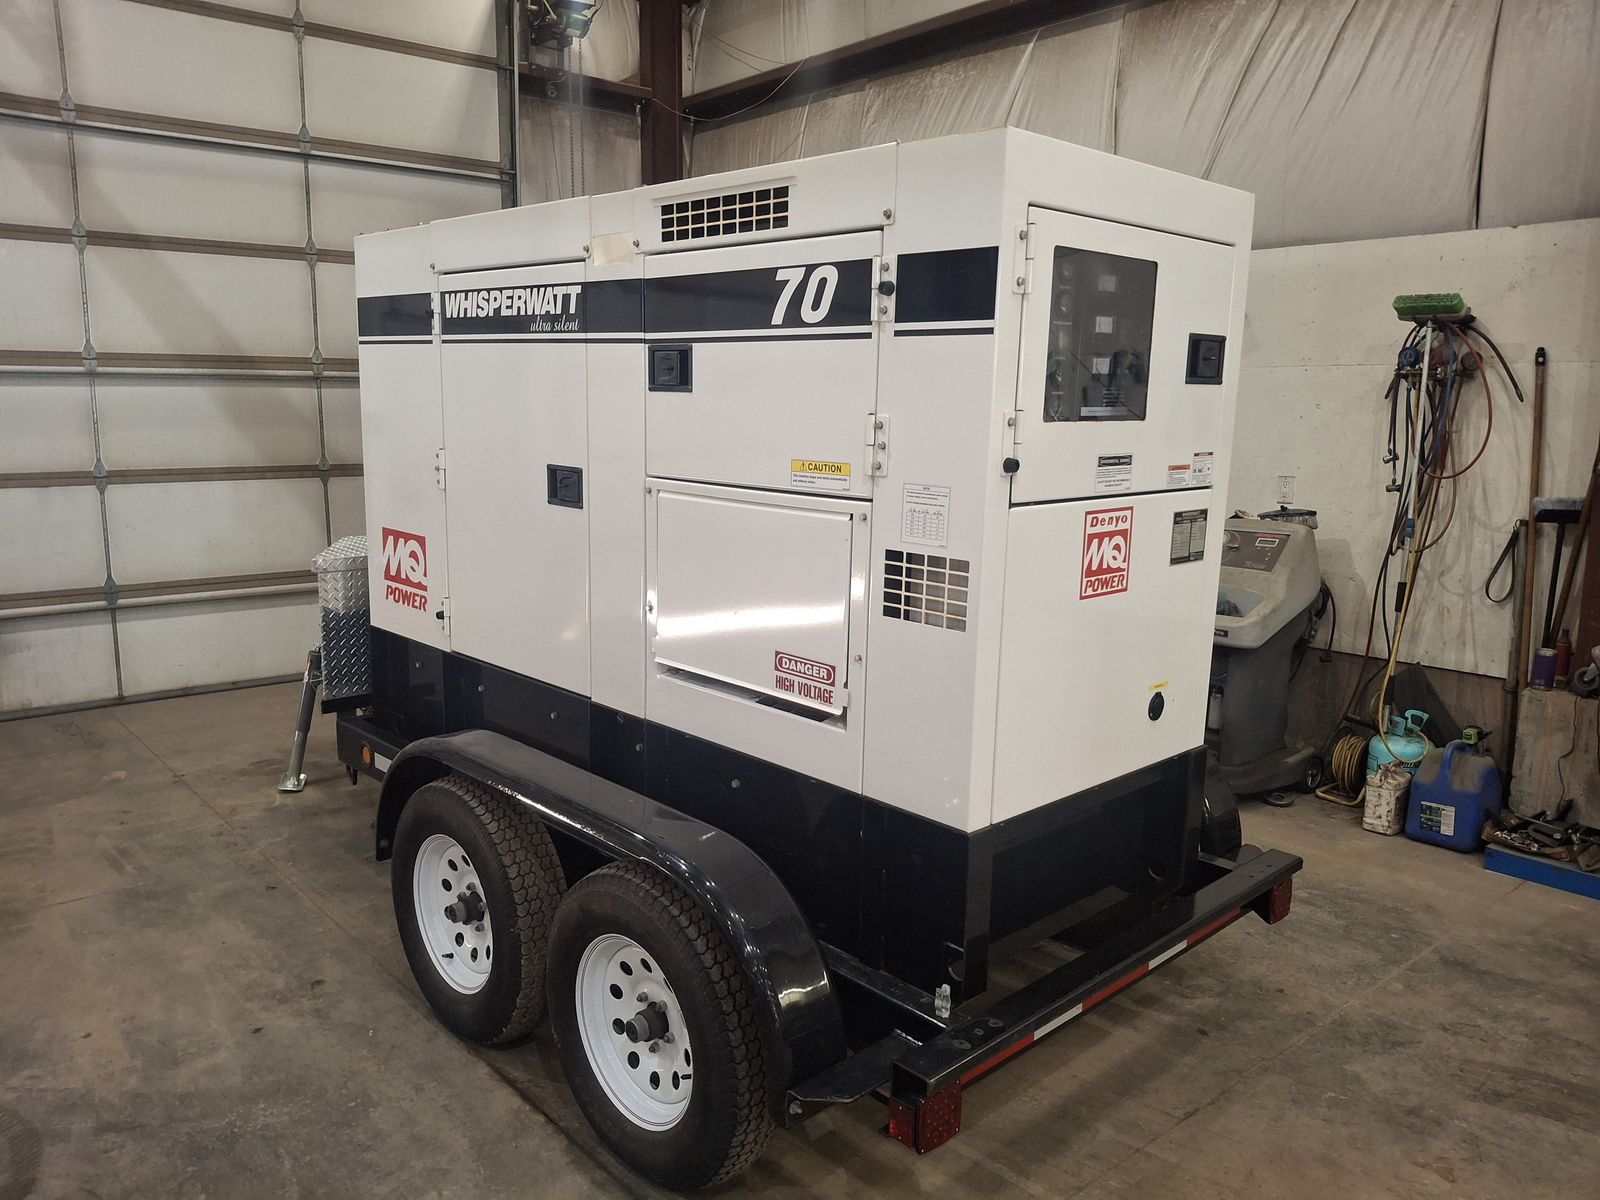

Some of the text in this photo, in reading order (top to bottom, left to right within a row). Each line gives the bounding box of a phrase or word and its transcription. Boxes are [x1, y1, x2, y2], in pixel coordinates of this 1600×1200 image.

[445, 285, 581, 318] WHISPERWATT
[770, 265, 839, 325] 70
[530, 315, 580, 332] ultra silent
[808, 463, 842, 473] CAUTION
[1090, 514, 1128, 528] Denyo
[383, 535, 427, 586] MQ
[1085, 535, 1126, 571] MQ
[386, 584, 428, 612] POWER
[1084, 574, 1125, 594] POWER
[782, 658, 828, 680] DANGER
[776, 675, 834, 704] HIGH VOLTAGE
